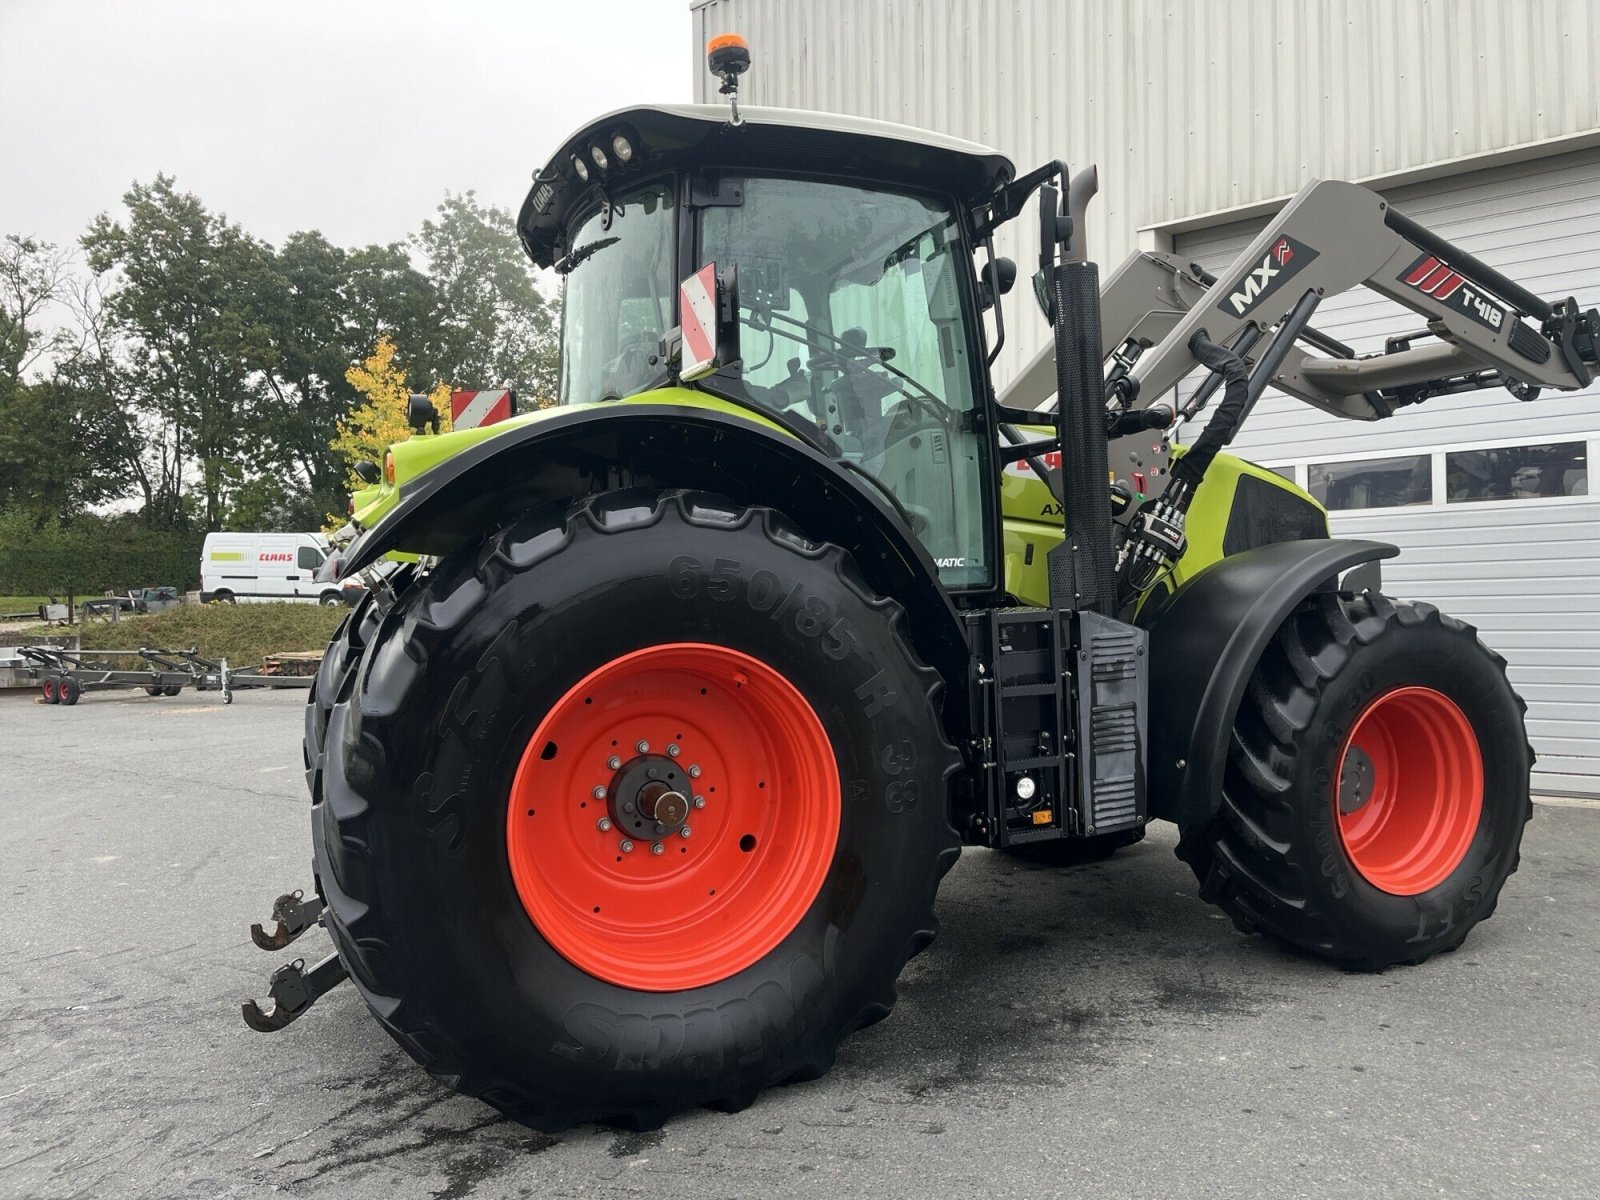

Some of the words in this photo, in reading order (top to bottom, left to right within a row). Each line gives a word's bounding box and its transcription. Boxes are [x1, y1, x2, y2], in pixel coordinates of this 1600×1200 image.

[1229, 254, 1280, 315] MX
[258, 552, 293, 562] CLAAS
[667, 554, 857, 661] 650/85
[854, 666, 898, 719] R
[881, 738, 921, 814] 38
